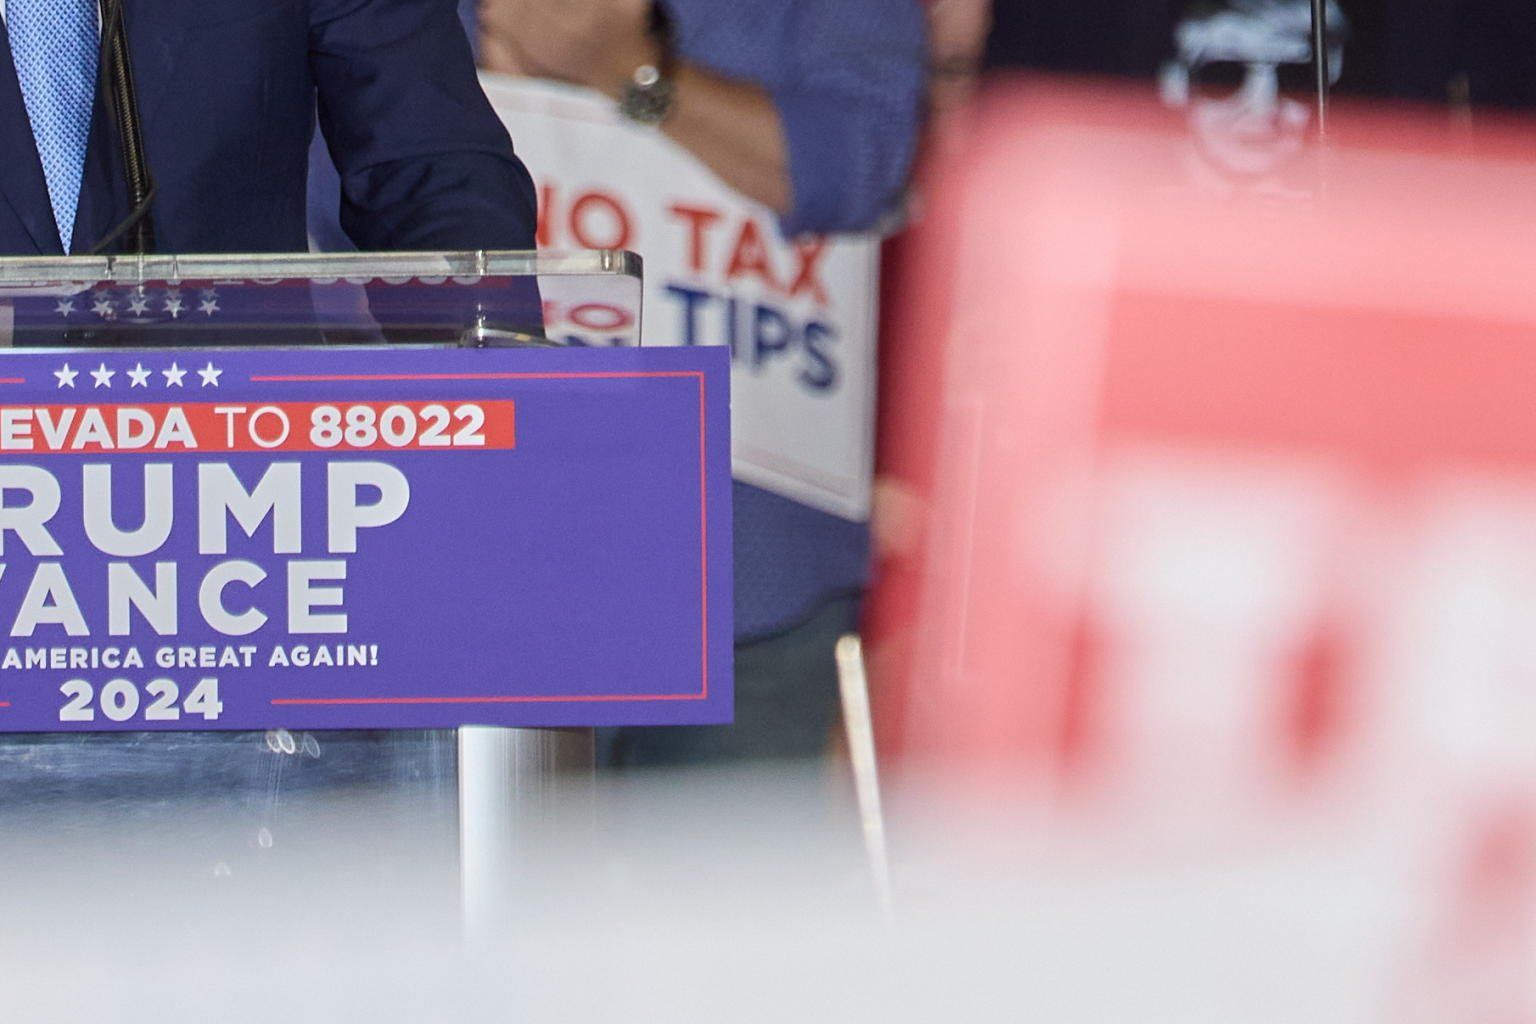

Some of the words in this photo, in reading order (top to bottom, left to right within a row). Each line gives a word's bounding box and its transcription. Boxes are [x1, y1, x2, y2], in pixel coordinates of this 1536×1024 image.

[667, 204, 831, 308] TAX
[664, 284, 839, 390] TIPS
[215, 406, 289, 448] TO
[310, 404, 485, 448] 88022
[1, 647, 143, 670] AMERICA
[155, 646, 256, 669] GREAT
[268, 644, 378, 667] AGAIN!
[59, 678, 223, 721] 2024
